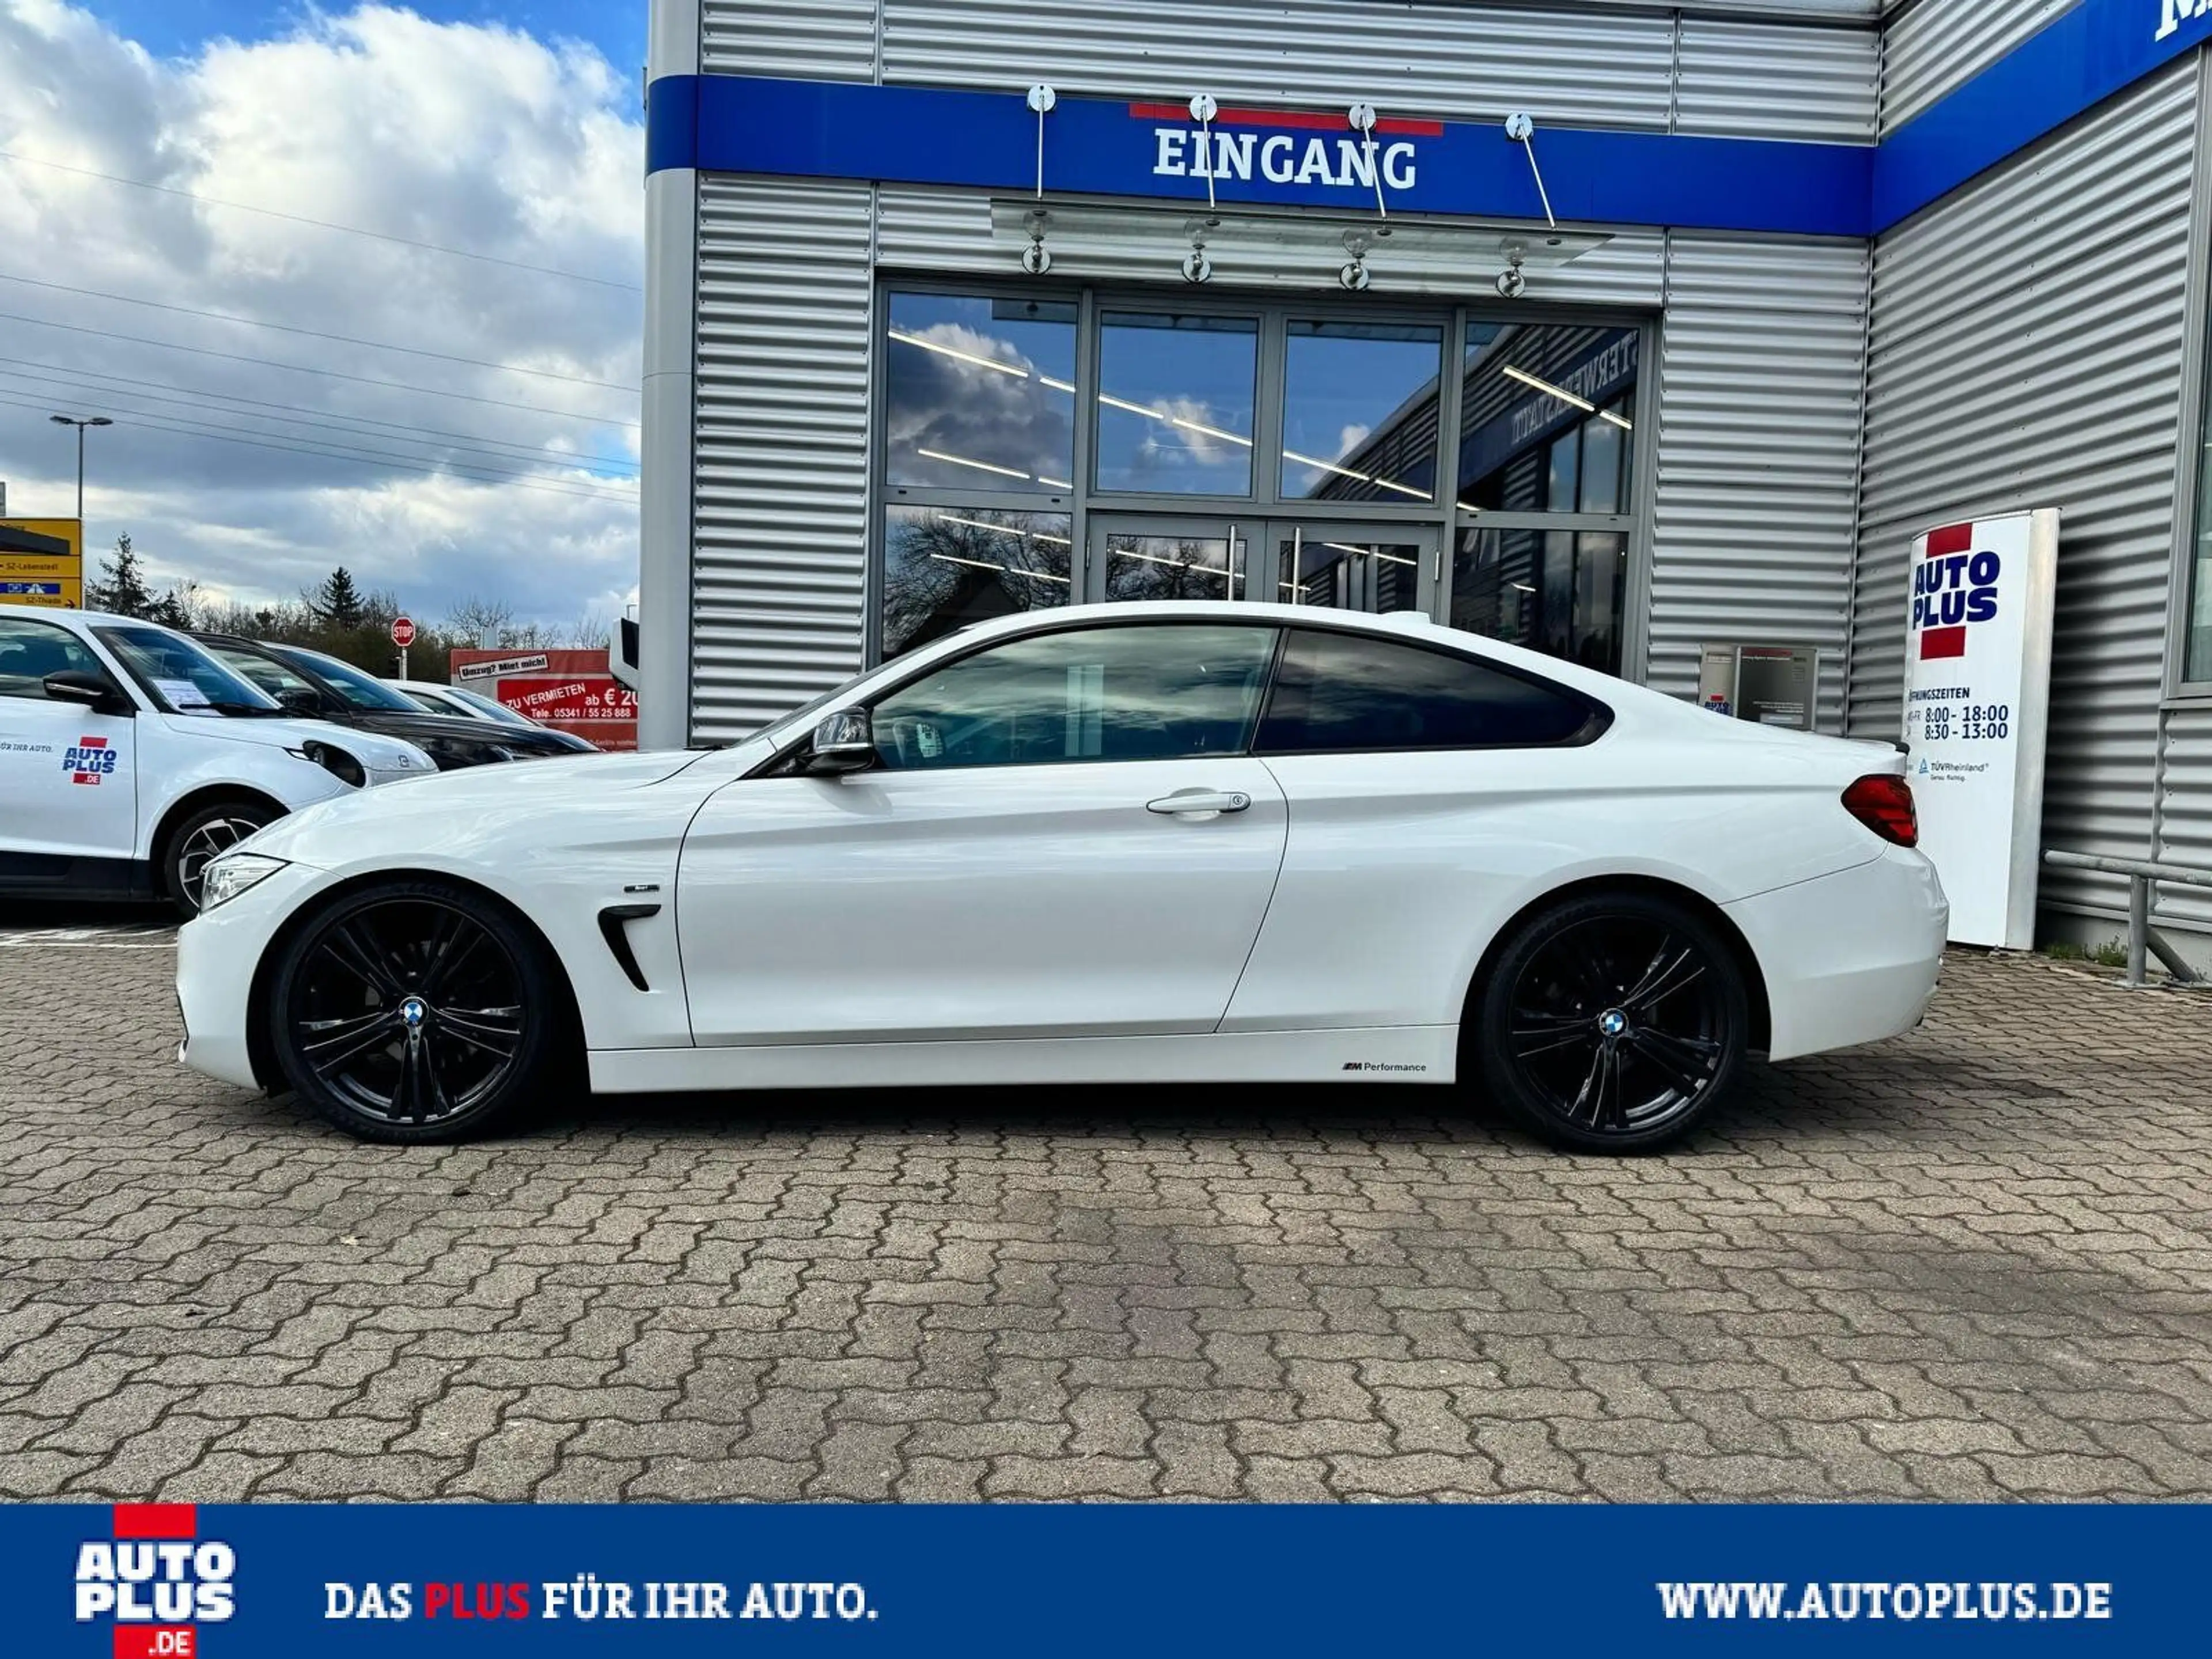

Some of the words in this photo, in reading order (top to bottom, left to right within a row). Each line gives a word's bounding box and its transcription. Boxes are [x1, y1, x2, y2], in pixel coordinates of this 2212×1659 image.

[1153, 128, 1416, 190] EINGANG
[1914, 551, 2001, 596] AUTO
[1913, 587, 1998, 631] PLUS
[394, 626, 413, 638] STOP
[505, 699, 521, 709] ZU
[523, 683, 586, 706] VERMIETEN
[585, 694, 600, 706] ab
[604, 688, 616, 706] €
[554, 709, 580, 717] 05341
[589, 709, 600, 717] 55
[601, 709, 612, 717] 25
[615, 709, 631, 717] 888
[1925, 707, 1949, 722] 8:00
[1962, 705, 2009, 722] 18:00
[1925, 724, 1949, 740] 8:30
[1962, 723, 2008, 739] 13:00
[65, 748, 117, 761] AUTO
[62, 759, 115, 773] PLUS
[1364, 1062, 1426, 1071] Performance
